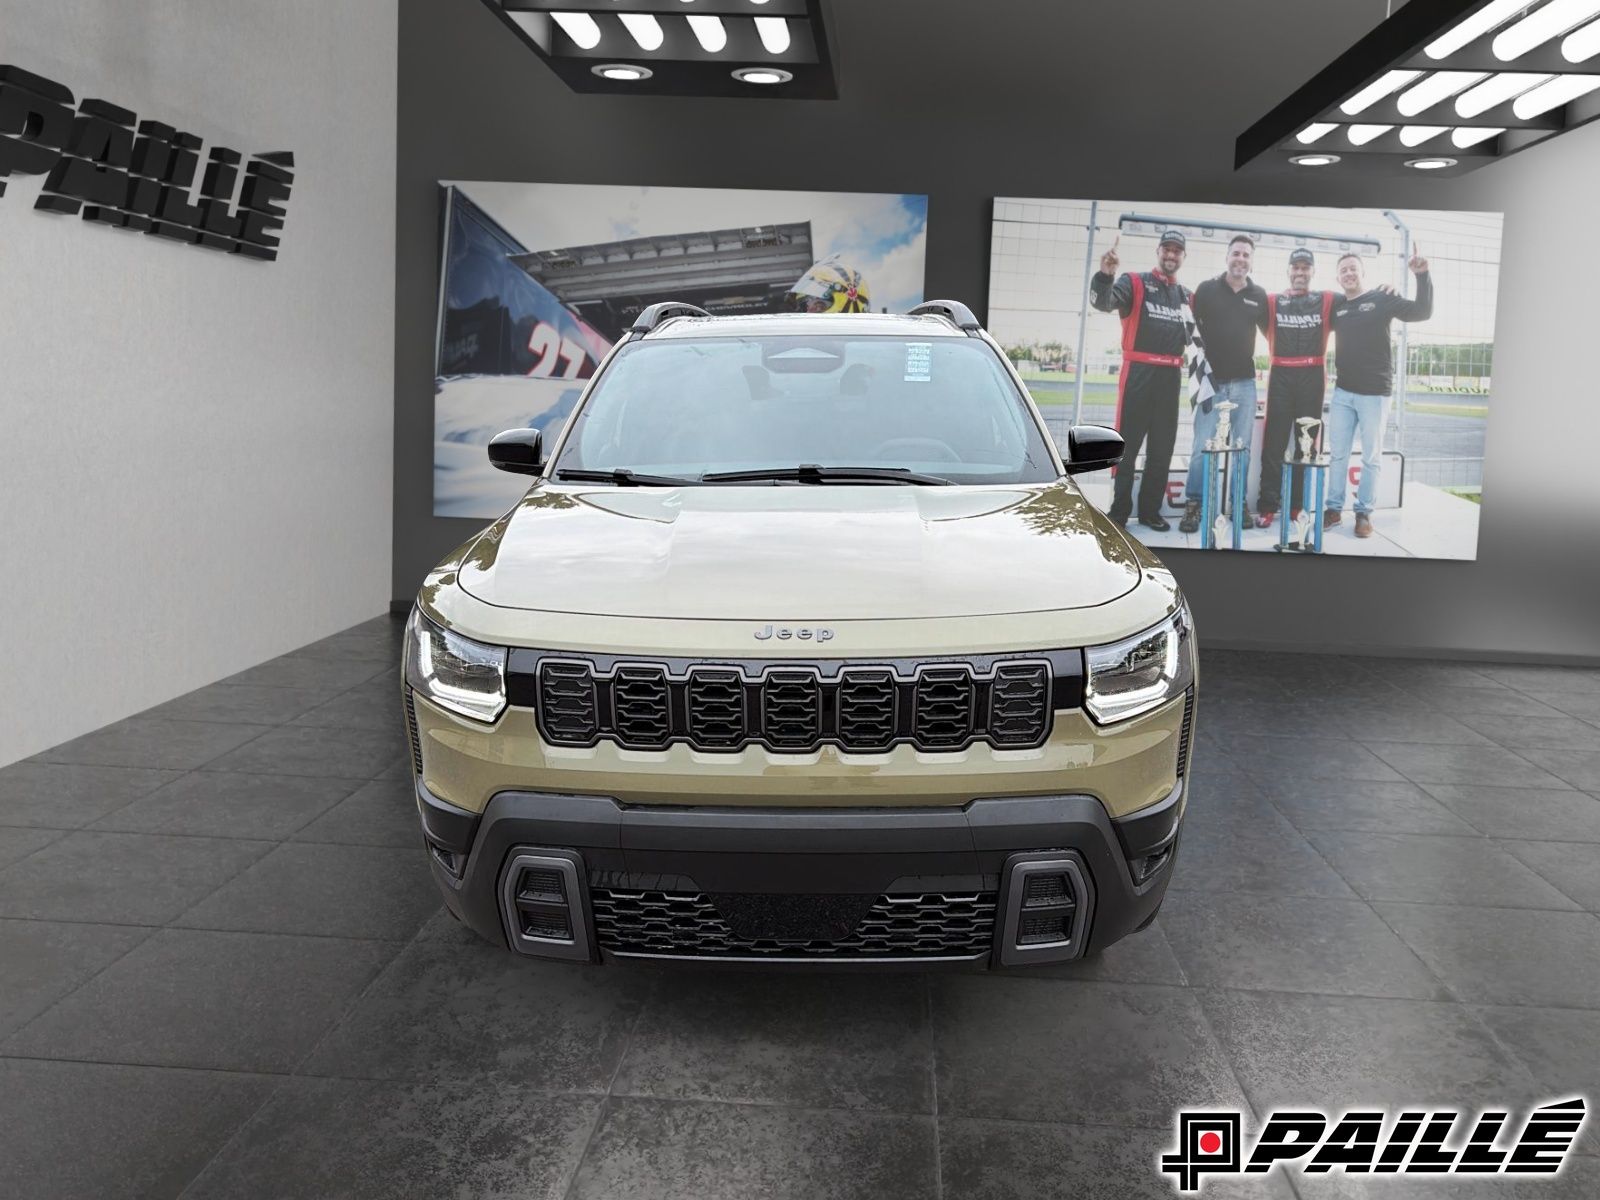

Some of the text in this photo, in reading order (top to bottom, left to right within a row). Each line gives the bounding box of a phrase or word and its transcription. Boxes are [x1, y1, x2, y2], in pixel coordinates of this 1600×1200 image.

[0, 64, 294, 261] PAILLÉ
[527, 320, 587, 379] 27
[754, 625, 834, 643] Jeep
